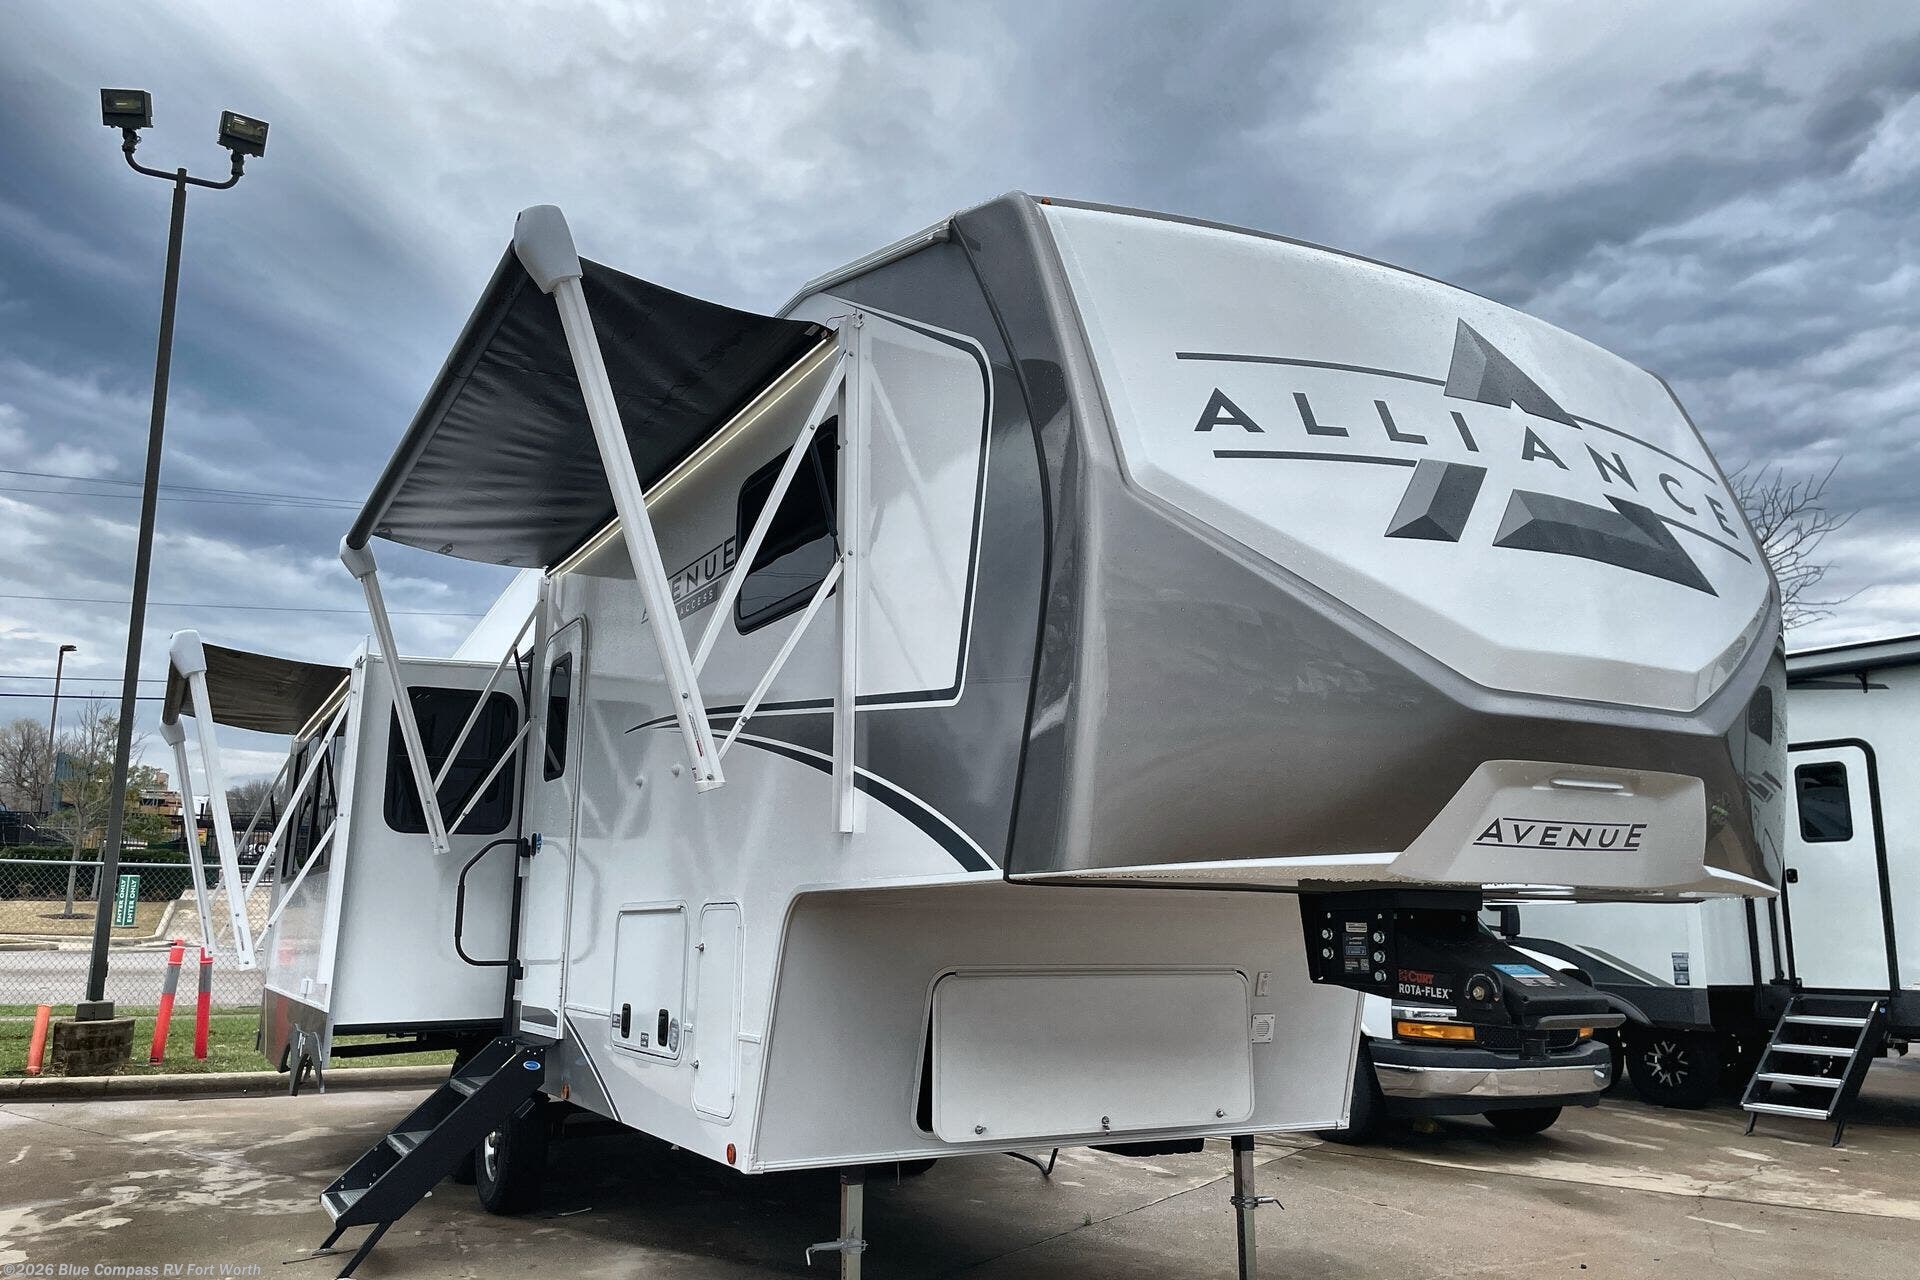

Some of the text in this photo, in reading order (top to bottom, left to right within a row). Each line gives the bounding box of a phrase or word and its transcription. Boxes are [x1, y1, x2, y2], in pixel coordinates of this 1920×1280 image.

[1194, 387, 1738, 540] ALLIANCE
[679, 590, 714, 616] ACCESS
[1475, 817, 1648, 848] AVENUE
[127, 901, 135, 923] ENTER
